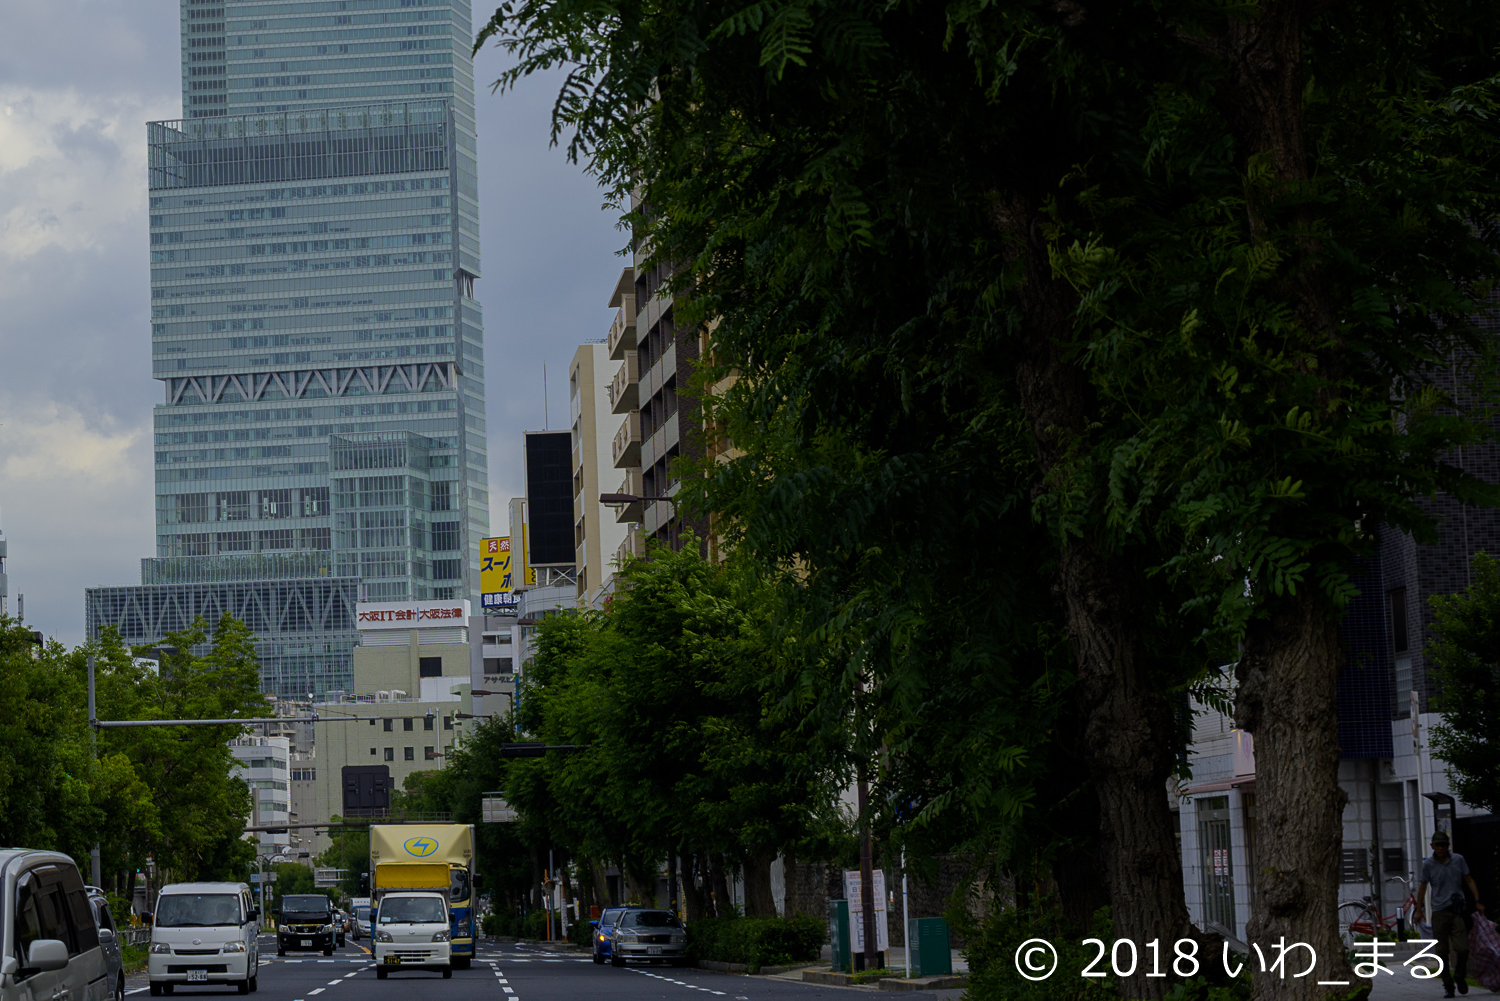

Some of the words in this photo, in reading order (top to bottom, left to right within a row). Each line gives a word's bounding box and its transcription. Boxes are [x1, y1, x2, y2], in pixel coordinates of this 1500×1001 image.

[488, 540, 510, 552] 天然
[419, 608, 462, 619] 大阪法律
